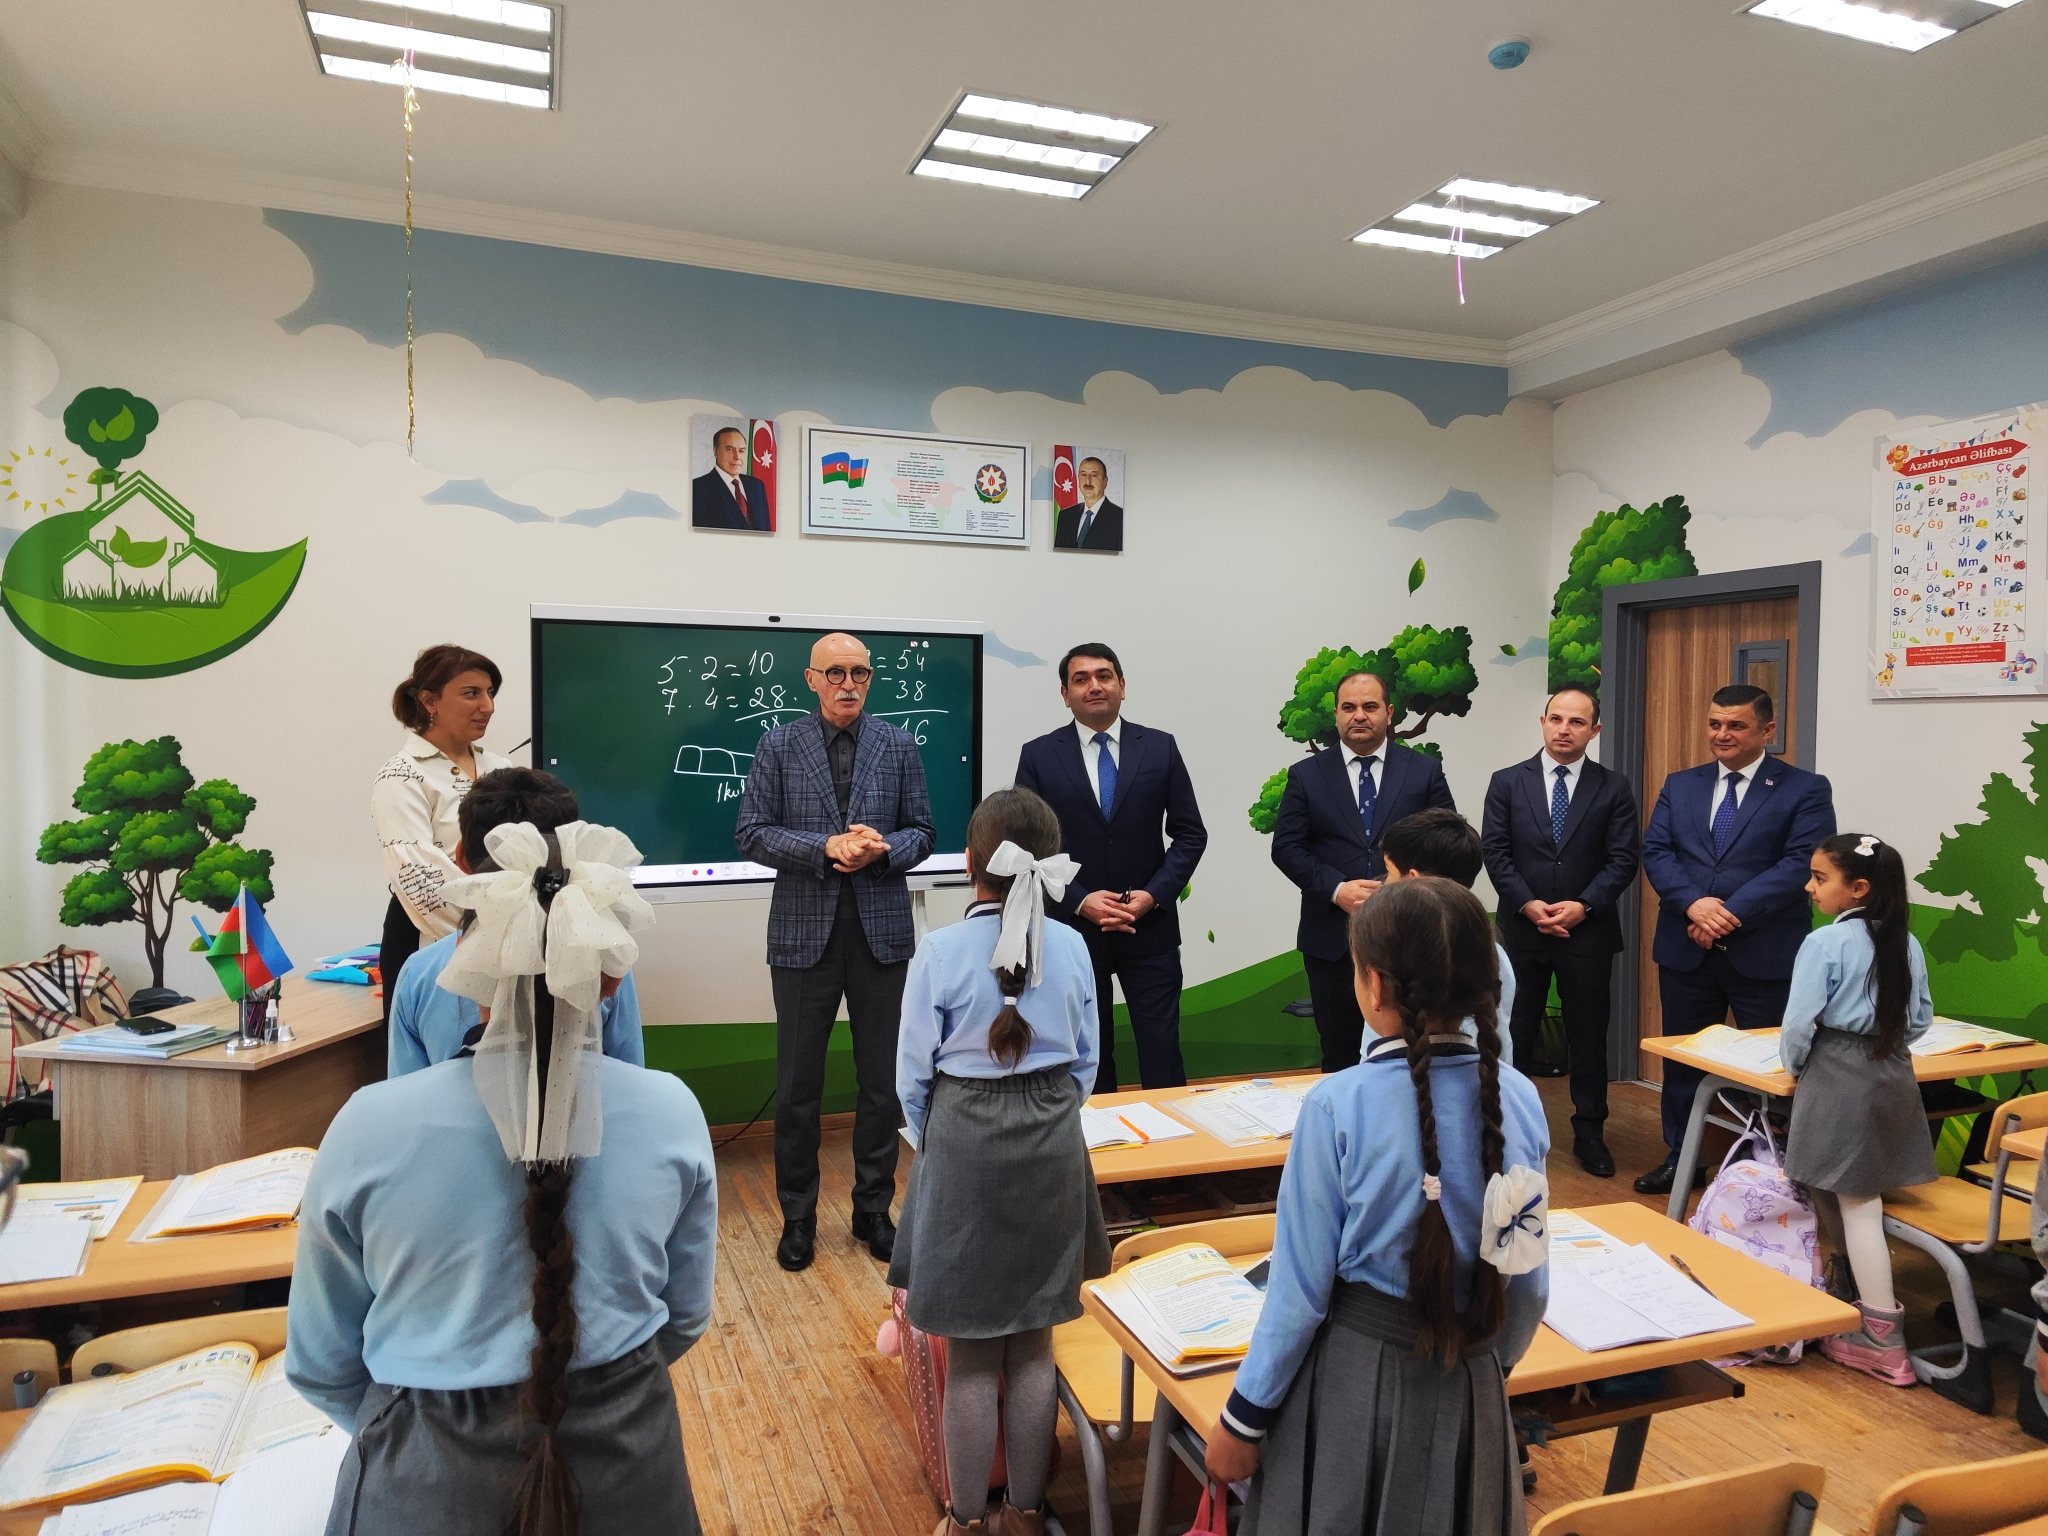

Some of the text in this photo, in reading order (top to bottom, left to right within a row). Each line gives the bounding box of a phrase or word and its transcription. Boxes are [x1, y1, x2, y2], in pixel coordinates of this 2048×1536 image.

[1908, 446, 2013, 473] Azərbaycan Əlifbası
[748, 649, 774, 675] 10
[896, 649, 925, 672] 54
[661, 688, 678, 715] 7
[704, 687, 718, 710] 4
[895, 680, 927, 702] 38
